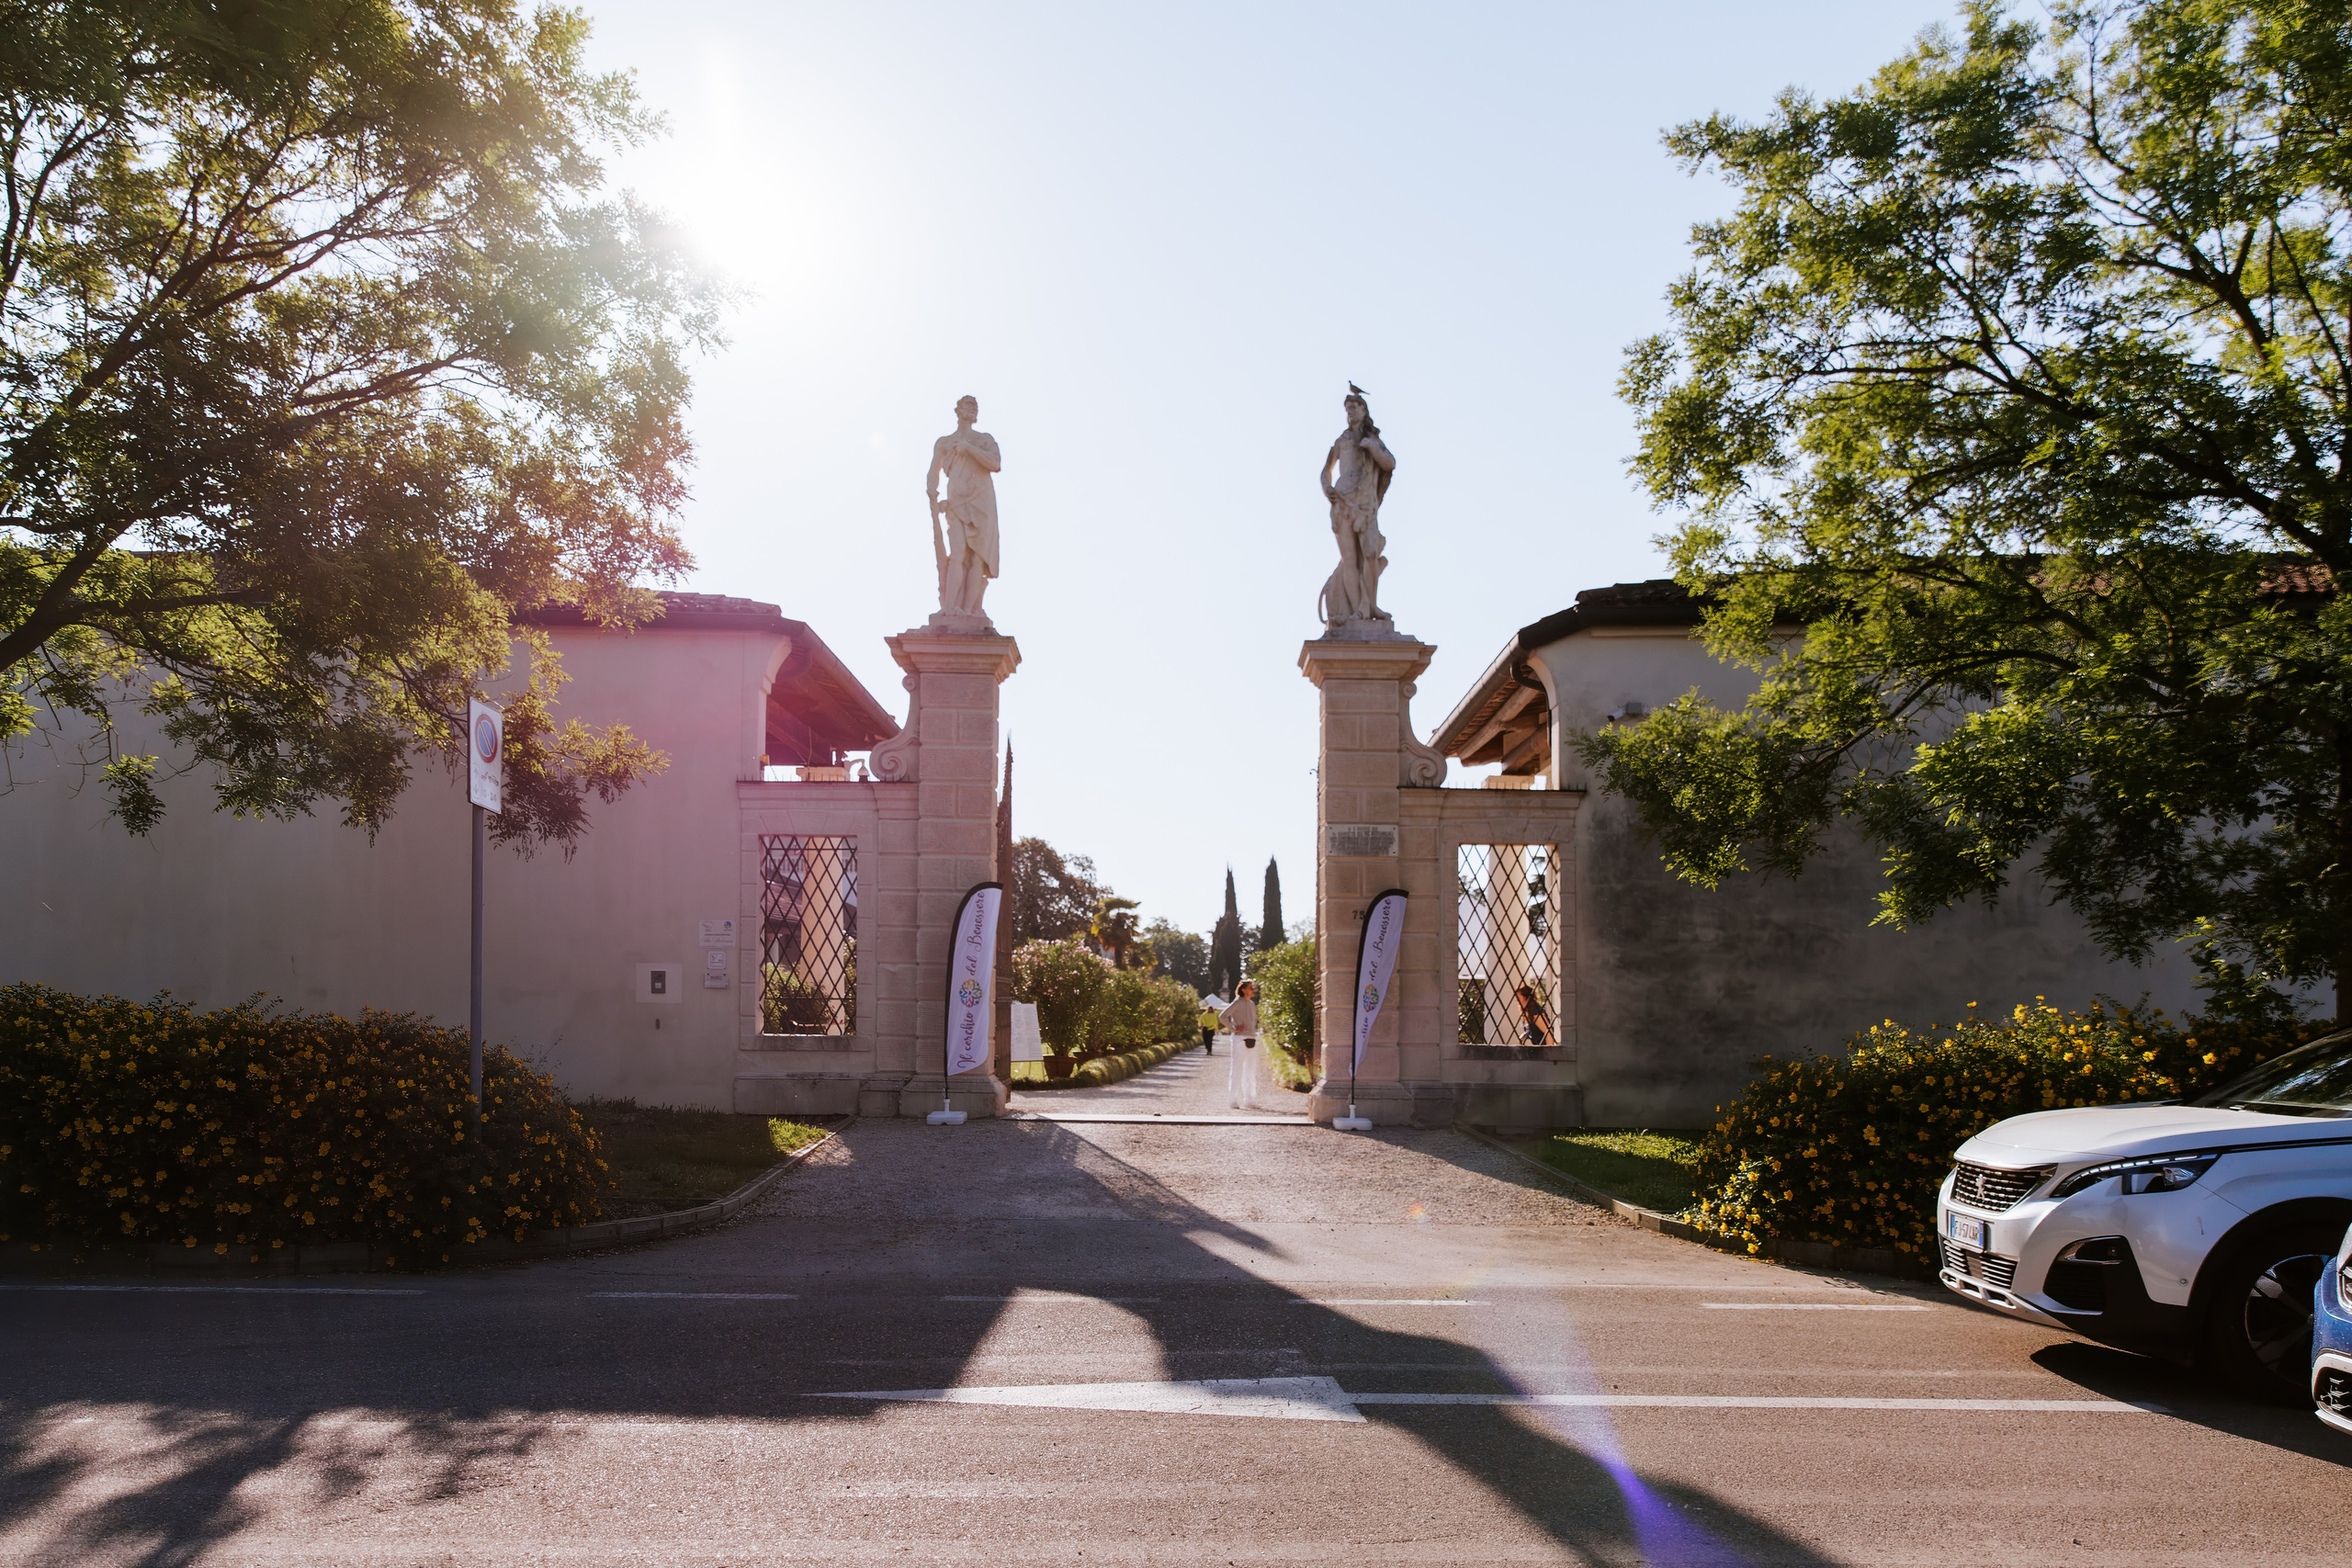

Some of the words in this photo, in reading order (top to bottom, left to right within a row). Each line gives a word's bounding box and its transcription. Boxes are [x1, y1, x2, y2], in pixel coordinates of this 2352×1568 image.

[967, 890, 985, 952] Benessere
[1373, 897, 1391, 958] Benessere
[966, 955, 978, 976] del
[960, 1011, 975, 1051] cerchio
[957, 1053, 976, 1068] Il
